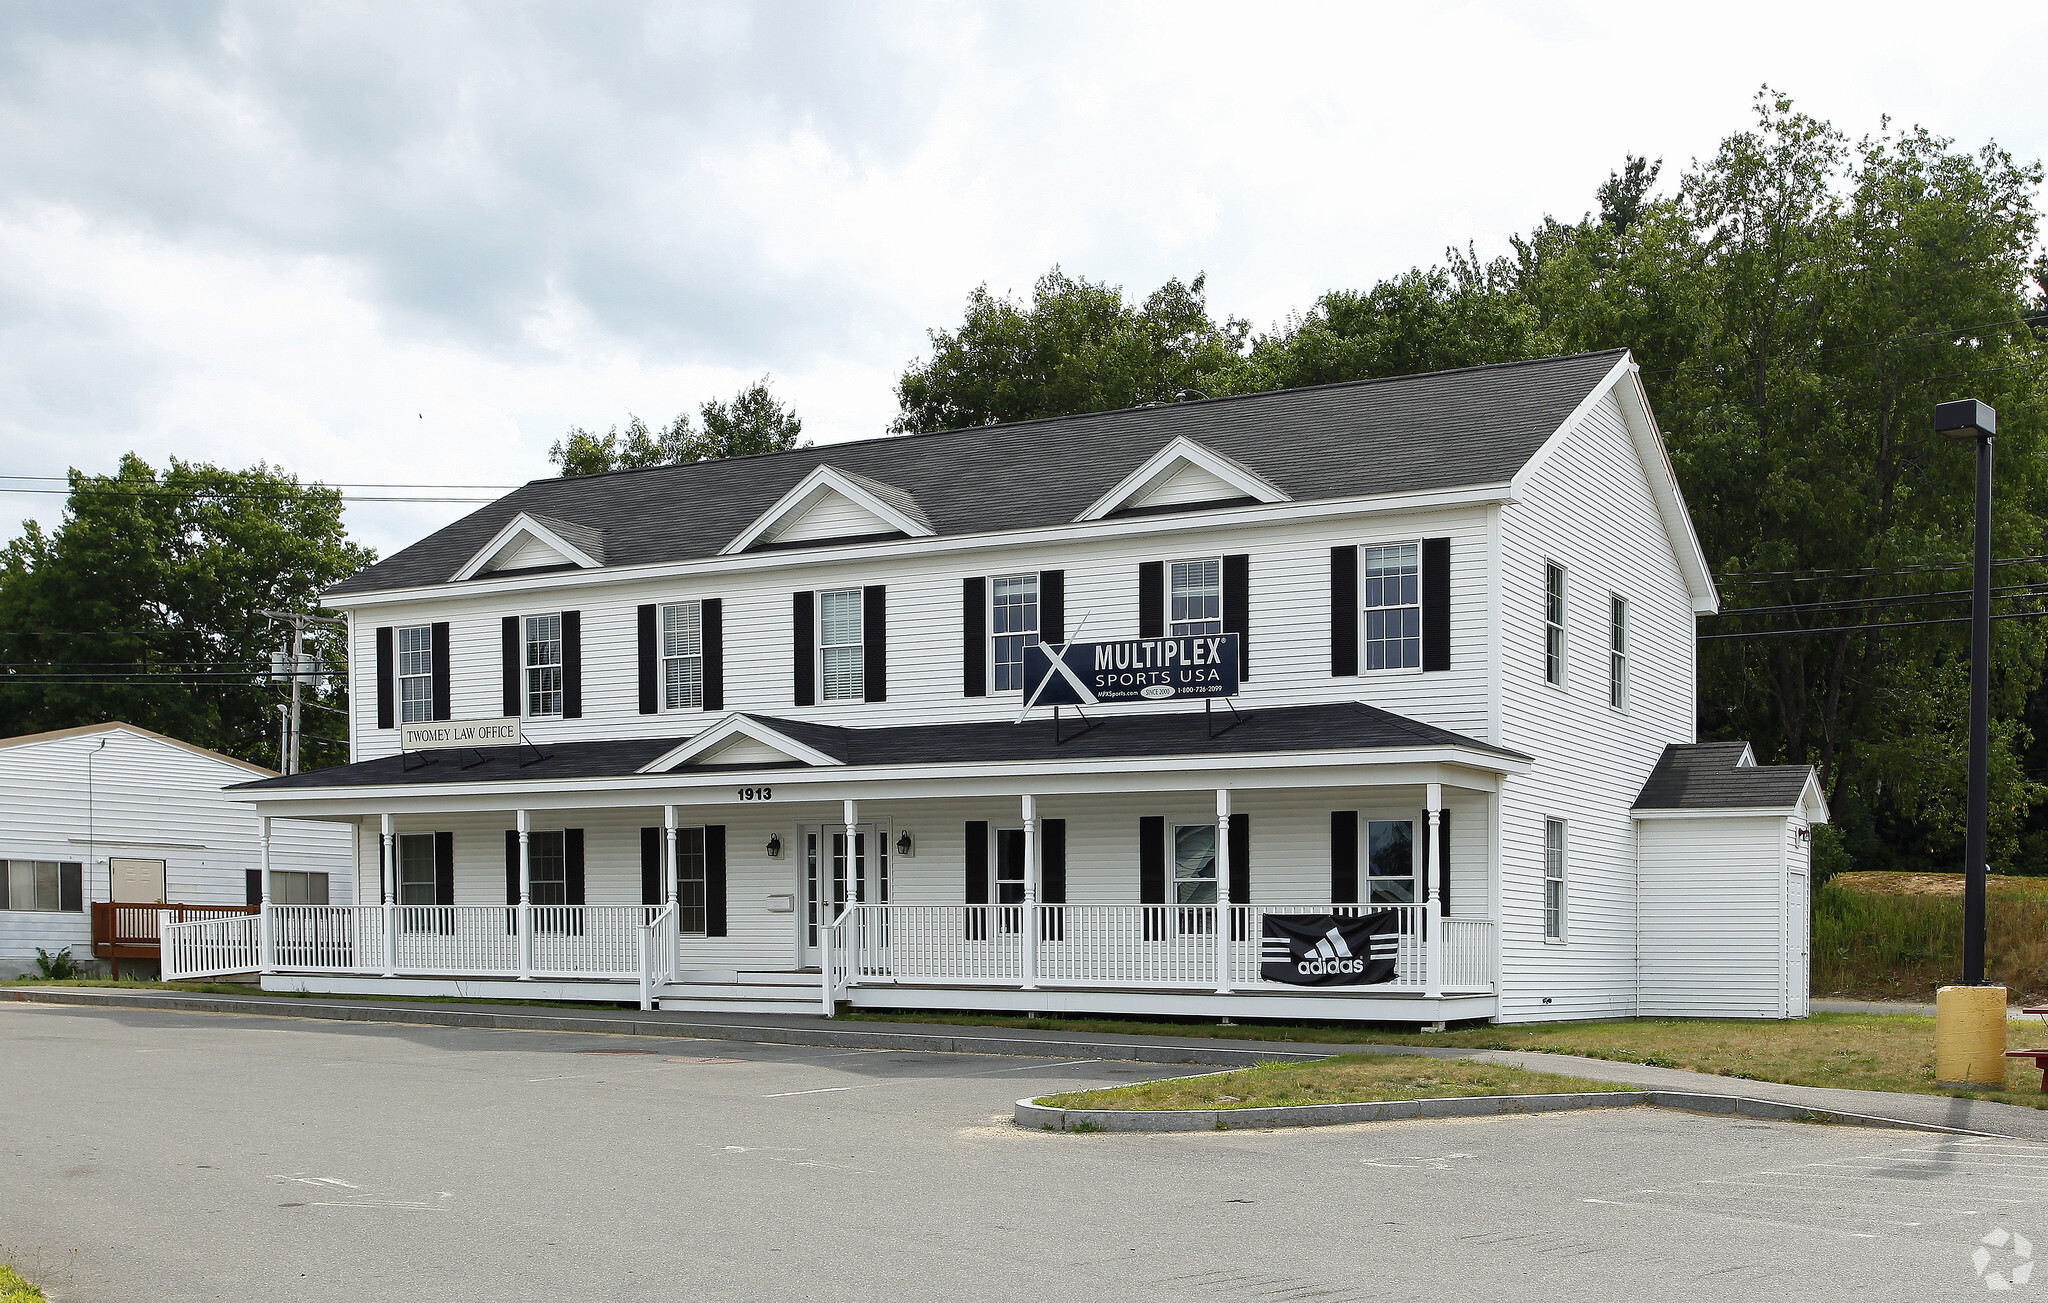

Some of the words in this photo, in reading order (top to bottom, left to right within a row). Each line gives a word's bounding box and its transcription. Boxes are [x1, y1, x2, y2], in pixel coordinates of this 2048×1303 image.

[1095, 671, 1171, 687] SPORTS
[1180, 669, 1220, 683] USA
[1145, 688, 1158, 696] SINCE
[407, 729, 451, 743] TWOMEY
[454, 727, 475, 740] LAW
[478, 725, 514, 739] OFFICE
[737, 787, 772, 801] 1913
[1297, 957, 1364, 975] adidas
